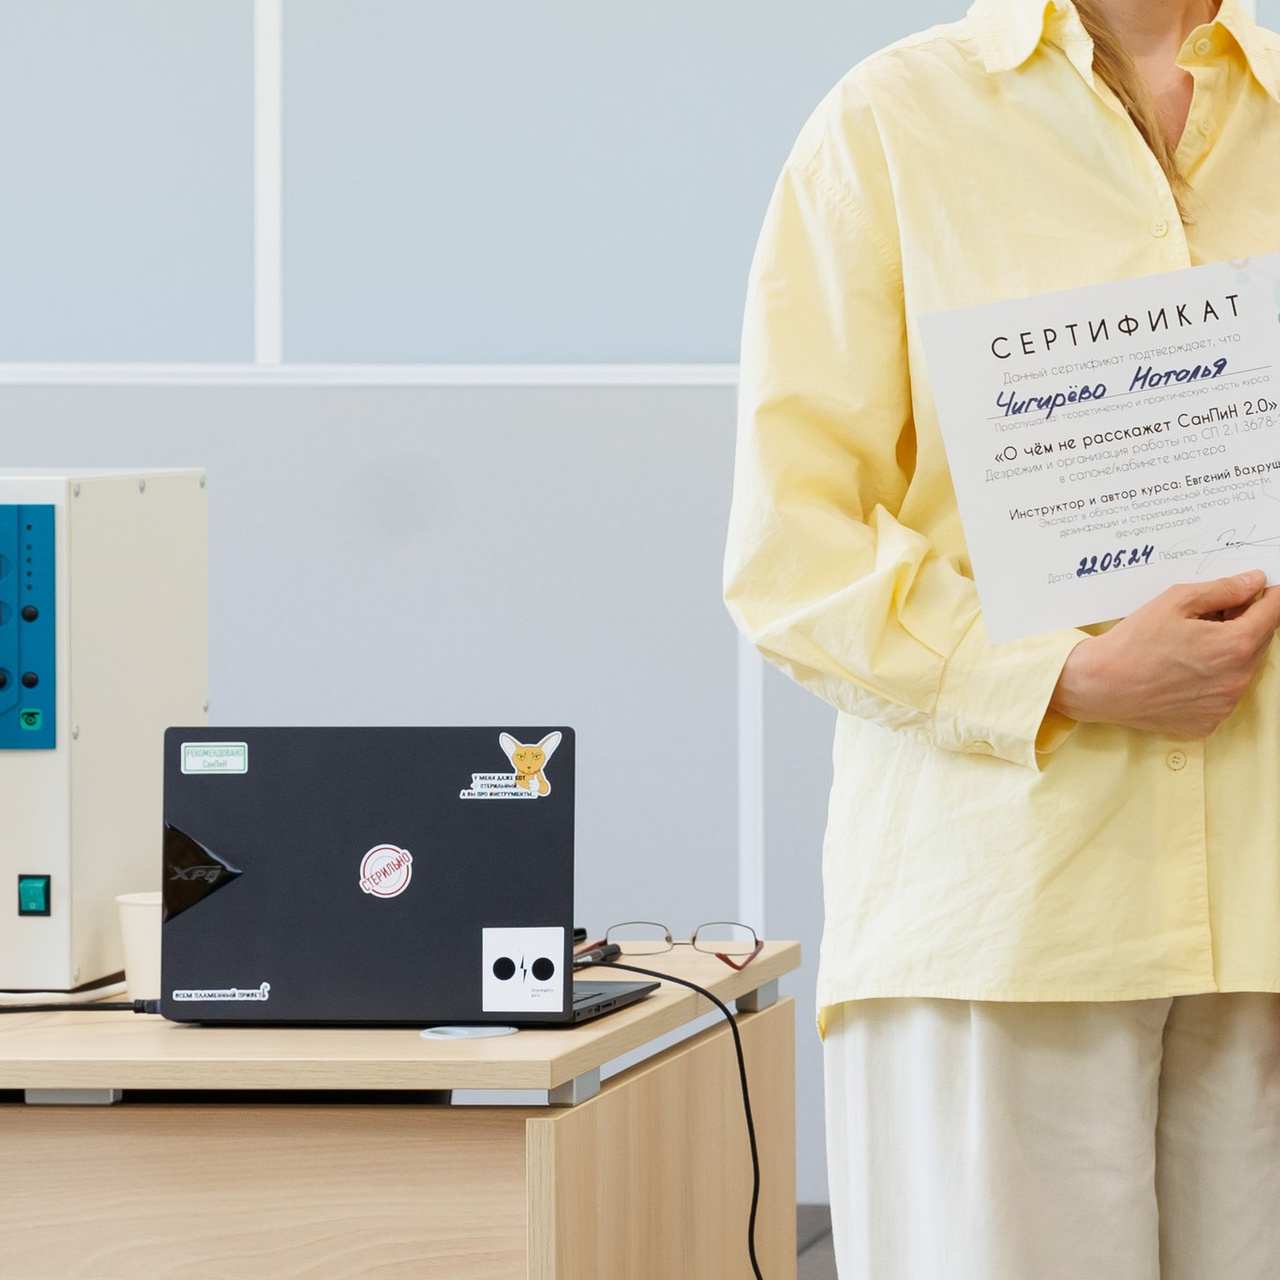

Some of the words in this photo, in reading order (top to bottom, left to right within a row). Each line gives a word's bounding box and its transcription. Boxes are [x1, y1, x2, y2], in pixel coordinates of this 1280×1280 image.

[990, 294, 1241, 360] СЕРТИФИКАТ
[1003, 368, 1048, 387] Данный
[1050, 355, 1127, 378] сертификат
[1128, 338, 1217, 365] подтверждает,
[1217, 333, 1242, 347] что
[1129, 357, 1228, 392] Наталья
[1144, 386, 1209, 406] практическую
[1210, 379, 1240, 393] часть
[1242, 374, 1271, 390] курса
[985, 462, 1044, 485] Дезрежим
[1056, 445, 1130, 472] организация
[1132, 436, 1180, 458] работы
[1183, 433, 1199, 446] по
[1201, 425, 1221, 441] СП
[994, 445, 1019, 464] «О
[1023, 438, 1054, 457] чём
[1058, 437, 1078, 452] не
[1083, 419, 1173, 449] расскажет
[1177, 402, 1239, 429] СанПиН
[1245, 398, 1279, 417] 2.0»
[1068, 453, 1171, 483] салоне/кабинете
[1173, 442, 1227, 463] мастера
[1008, 497, 1086, 522] Инструктор
[1089, 496, 1098, 507] и
[1100, 488, 1138, 508] автор
[1141, 480, 1183, 500] курса:
[1185, 468, 1232, 488] Евгений
[1038, 513, 1079, 530] Эксперт
[1089, 504, 1130, 519] области
[1131, 488, 1202, 511] биологической
[361, 852, 411, 892] СТЕРИЛЬНО
